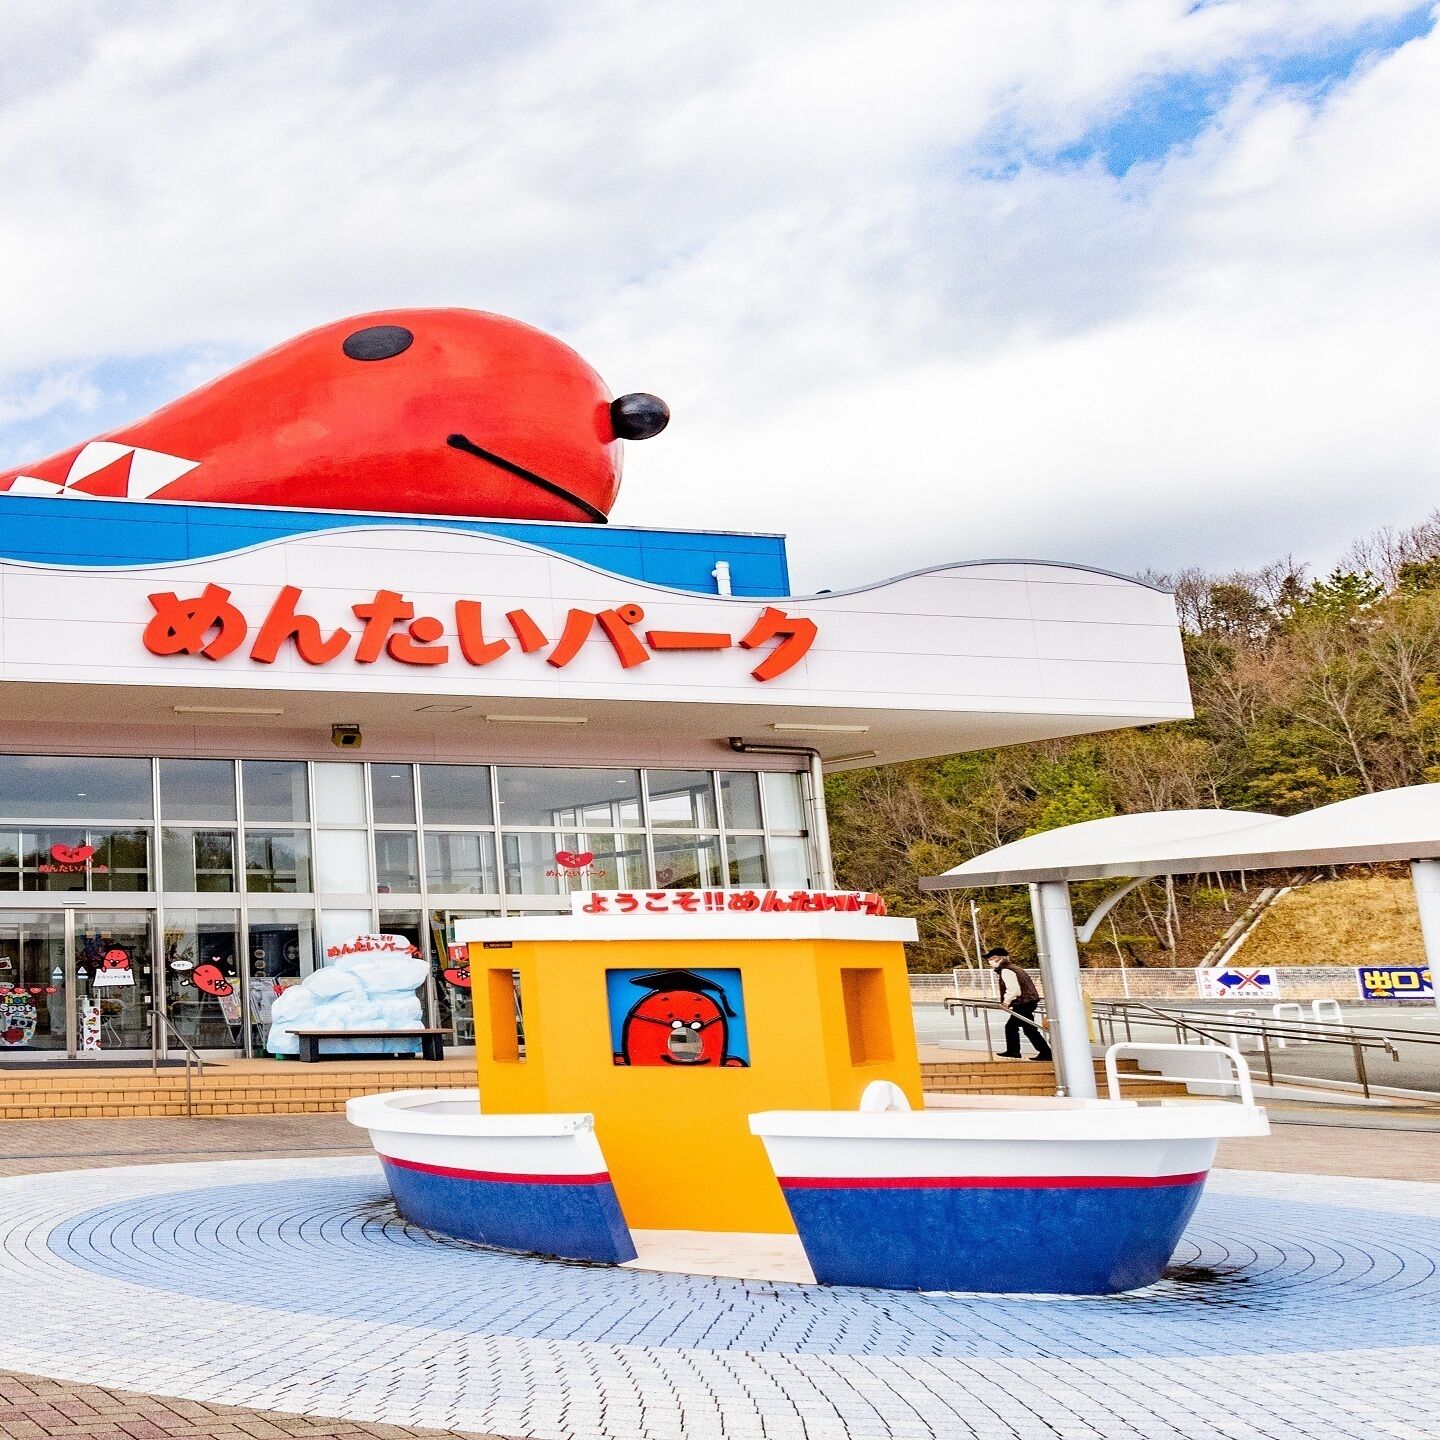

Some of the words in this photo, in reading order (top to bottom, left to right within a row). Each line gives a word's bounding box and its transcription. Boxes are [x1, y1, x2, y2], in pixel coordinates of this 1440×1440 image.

[142, 582, 819, 683] めんたいパーク
[545, 869, 606, 878] めんたいパーク
[1363, 970, 1420, 990] 出口
[0, 1003, 33, 1013] Spot
